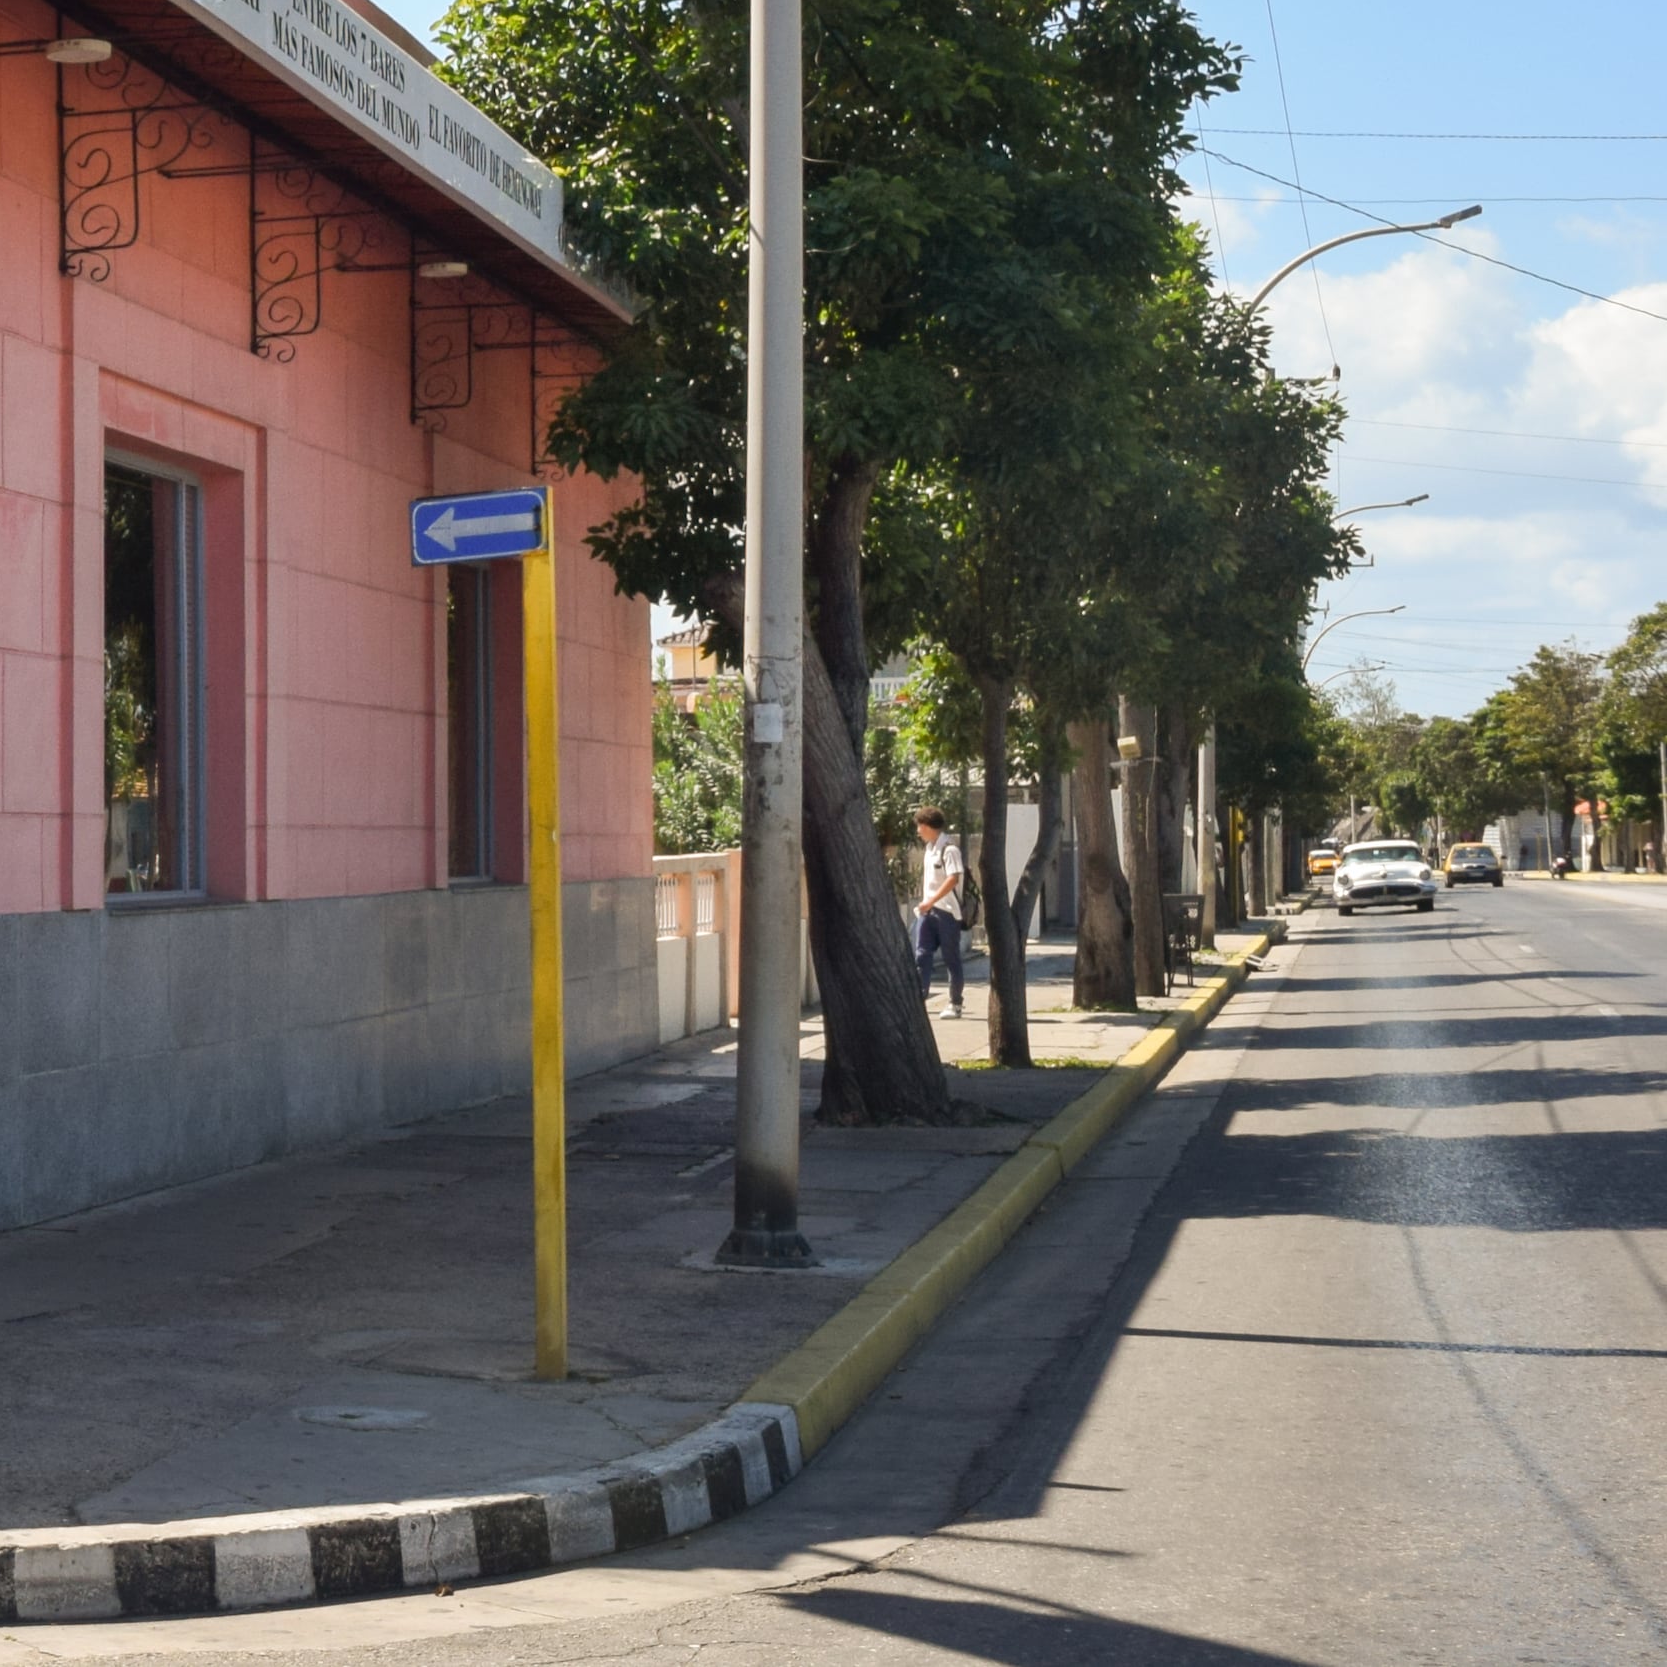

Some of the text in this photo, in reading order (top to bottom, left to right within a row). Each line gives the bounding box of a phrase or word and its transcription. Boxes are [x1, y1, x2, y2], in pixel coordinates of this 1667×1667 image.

[272, 9, 420, 150] MÁS FAMOSOS DEL MUNDO
[335, 11, 357, 57] LOS
[361, 32, 367, 65] 7
[370, 40, 405, 94] BARES
[429, 104, 441, 145] EL
[444, 114, 487, 176] FAVORITO
[489, 149, 501, 189] DE
